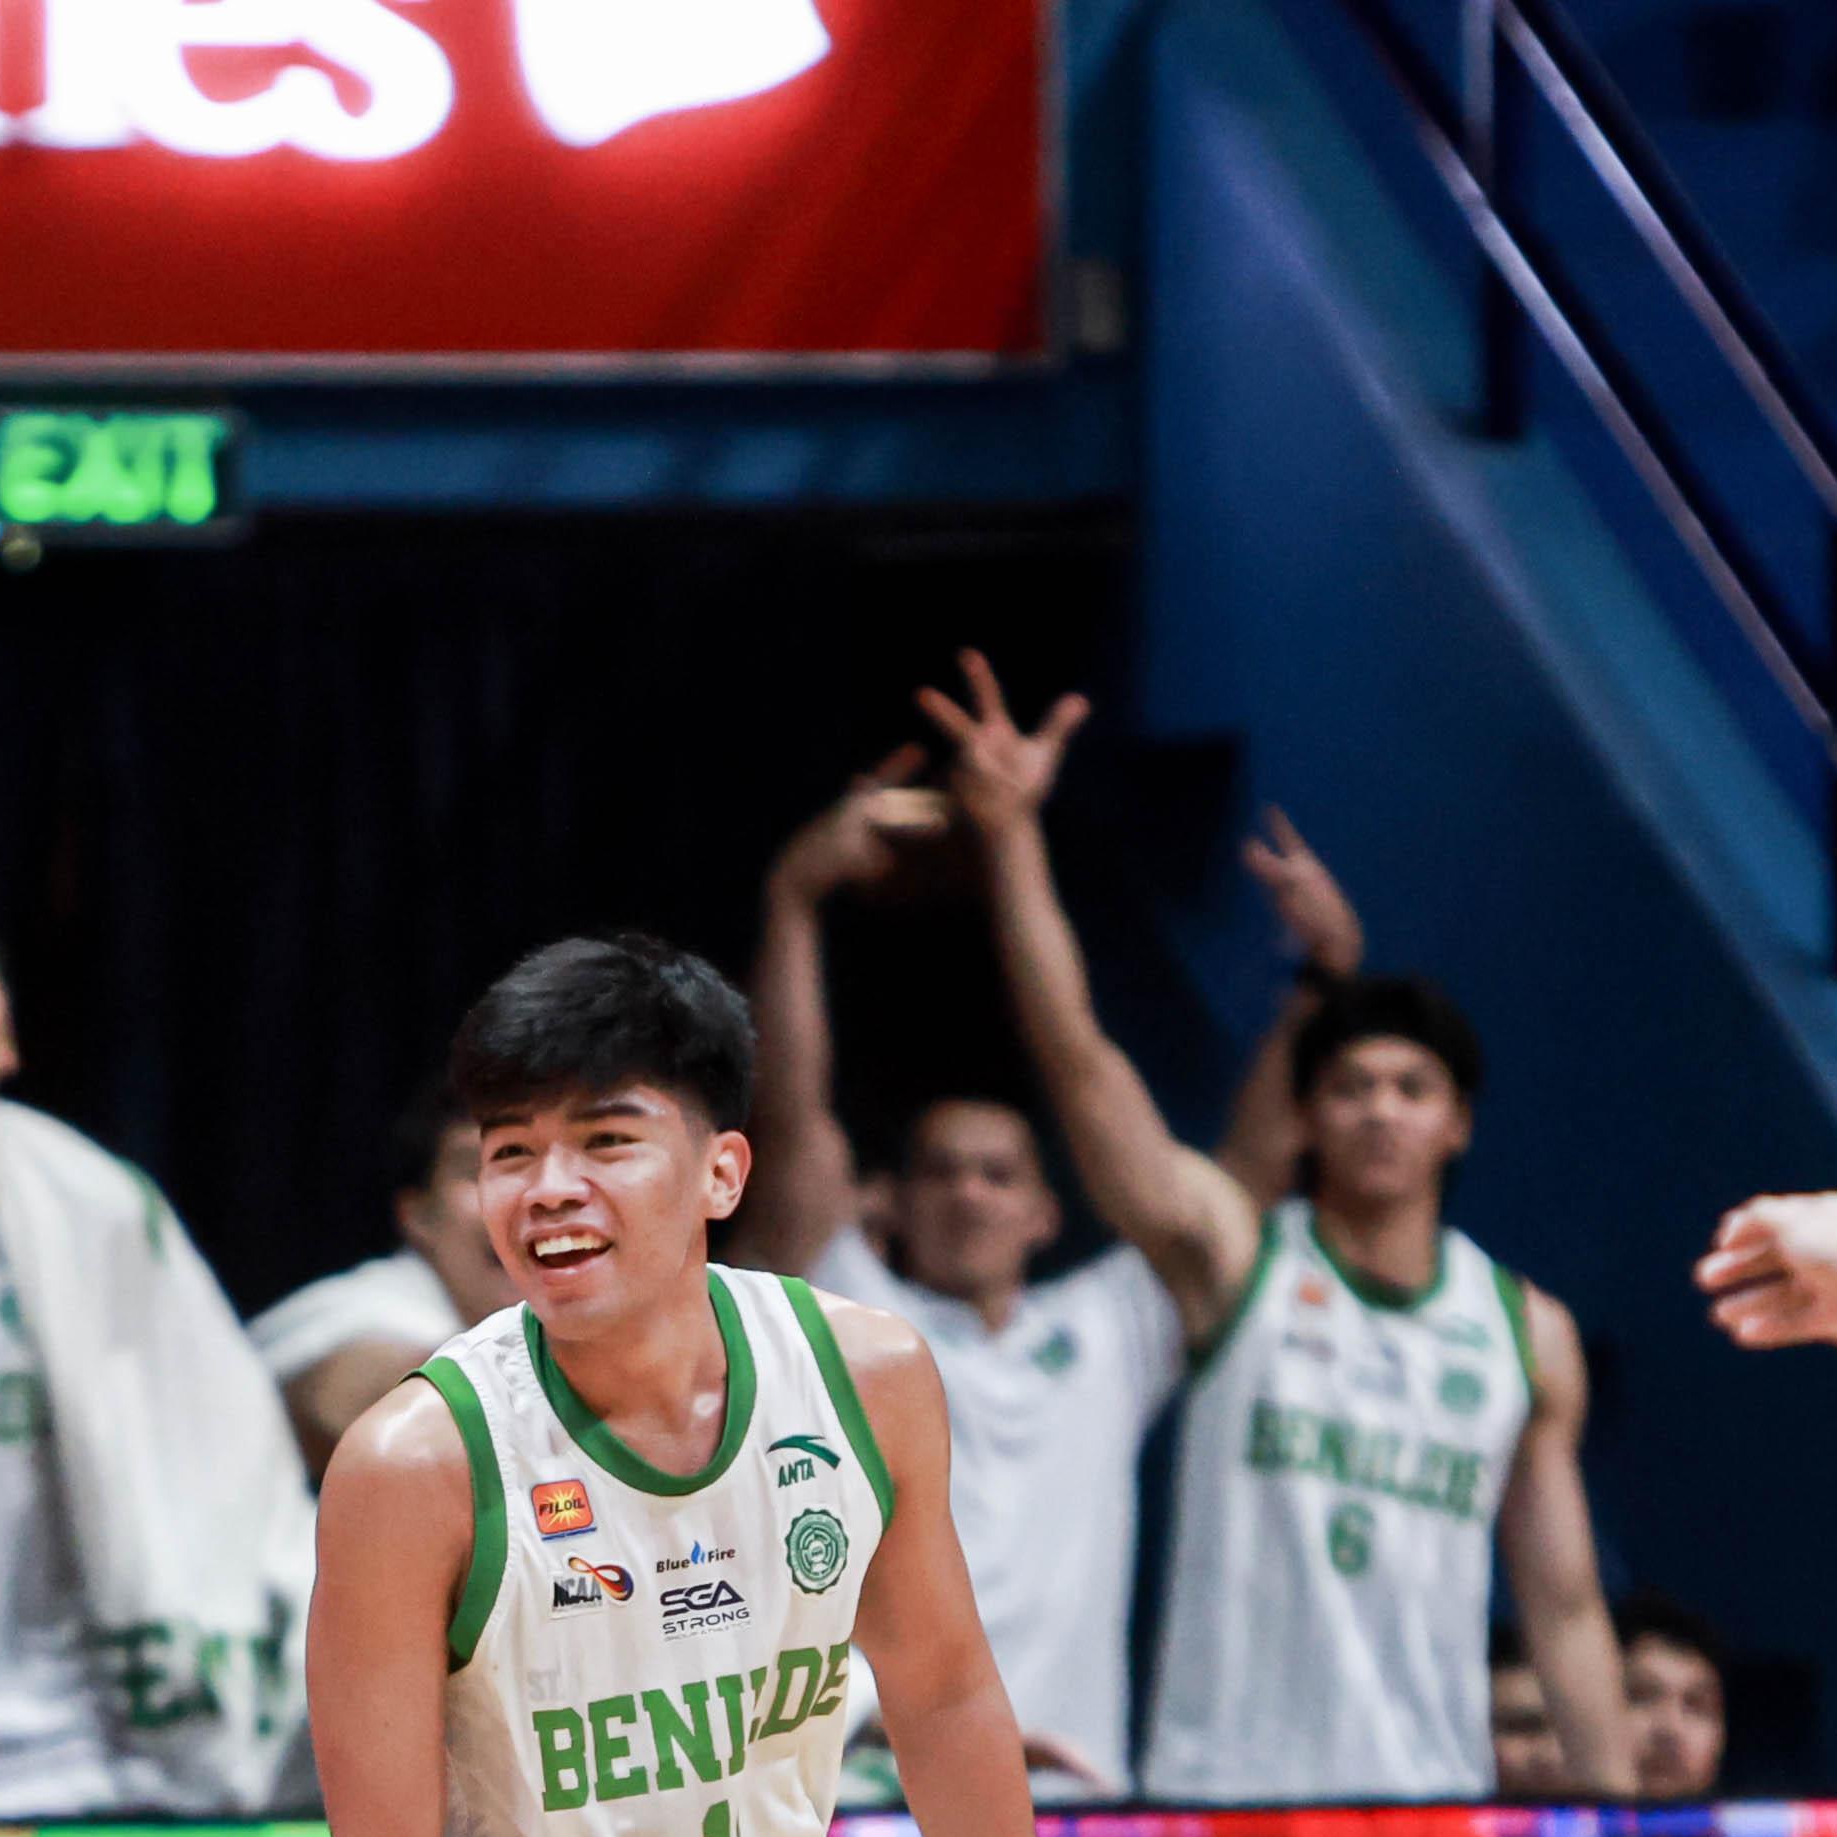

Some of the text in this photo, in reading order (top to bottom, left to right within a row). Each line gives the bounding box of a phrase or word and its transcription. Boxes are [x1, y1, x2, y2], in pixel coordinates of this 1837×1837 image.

[778, 1458, 816, 1488] ANTA
[1327, 1501, 1374, 1578] 6
[656, 1549, 736, 1573] Blue Fire
[553, 1577, 602, 1607] NCAA
[660, 1580, 745, 1617] SGA
[663, 1607, 750, 1634] STRONG
